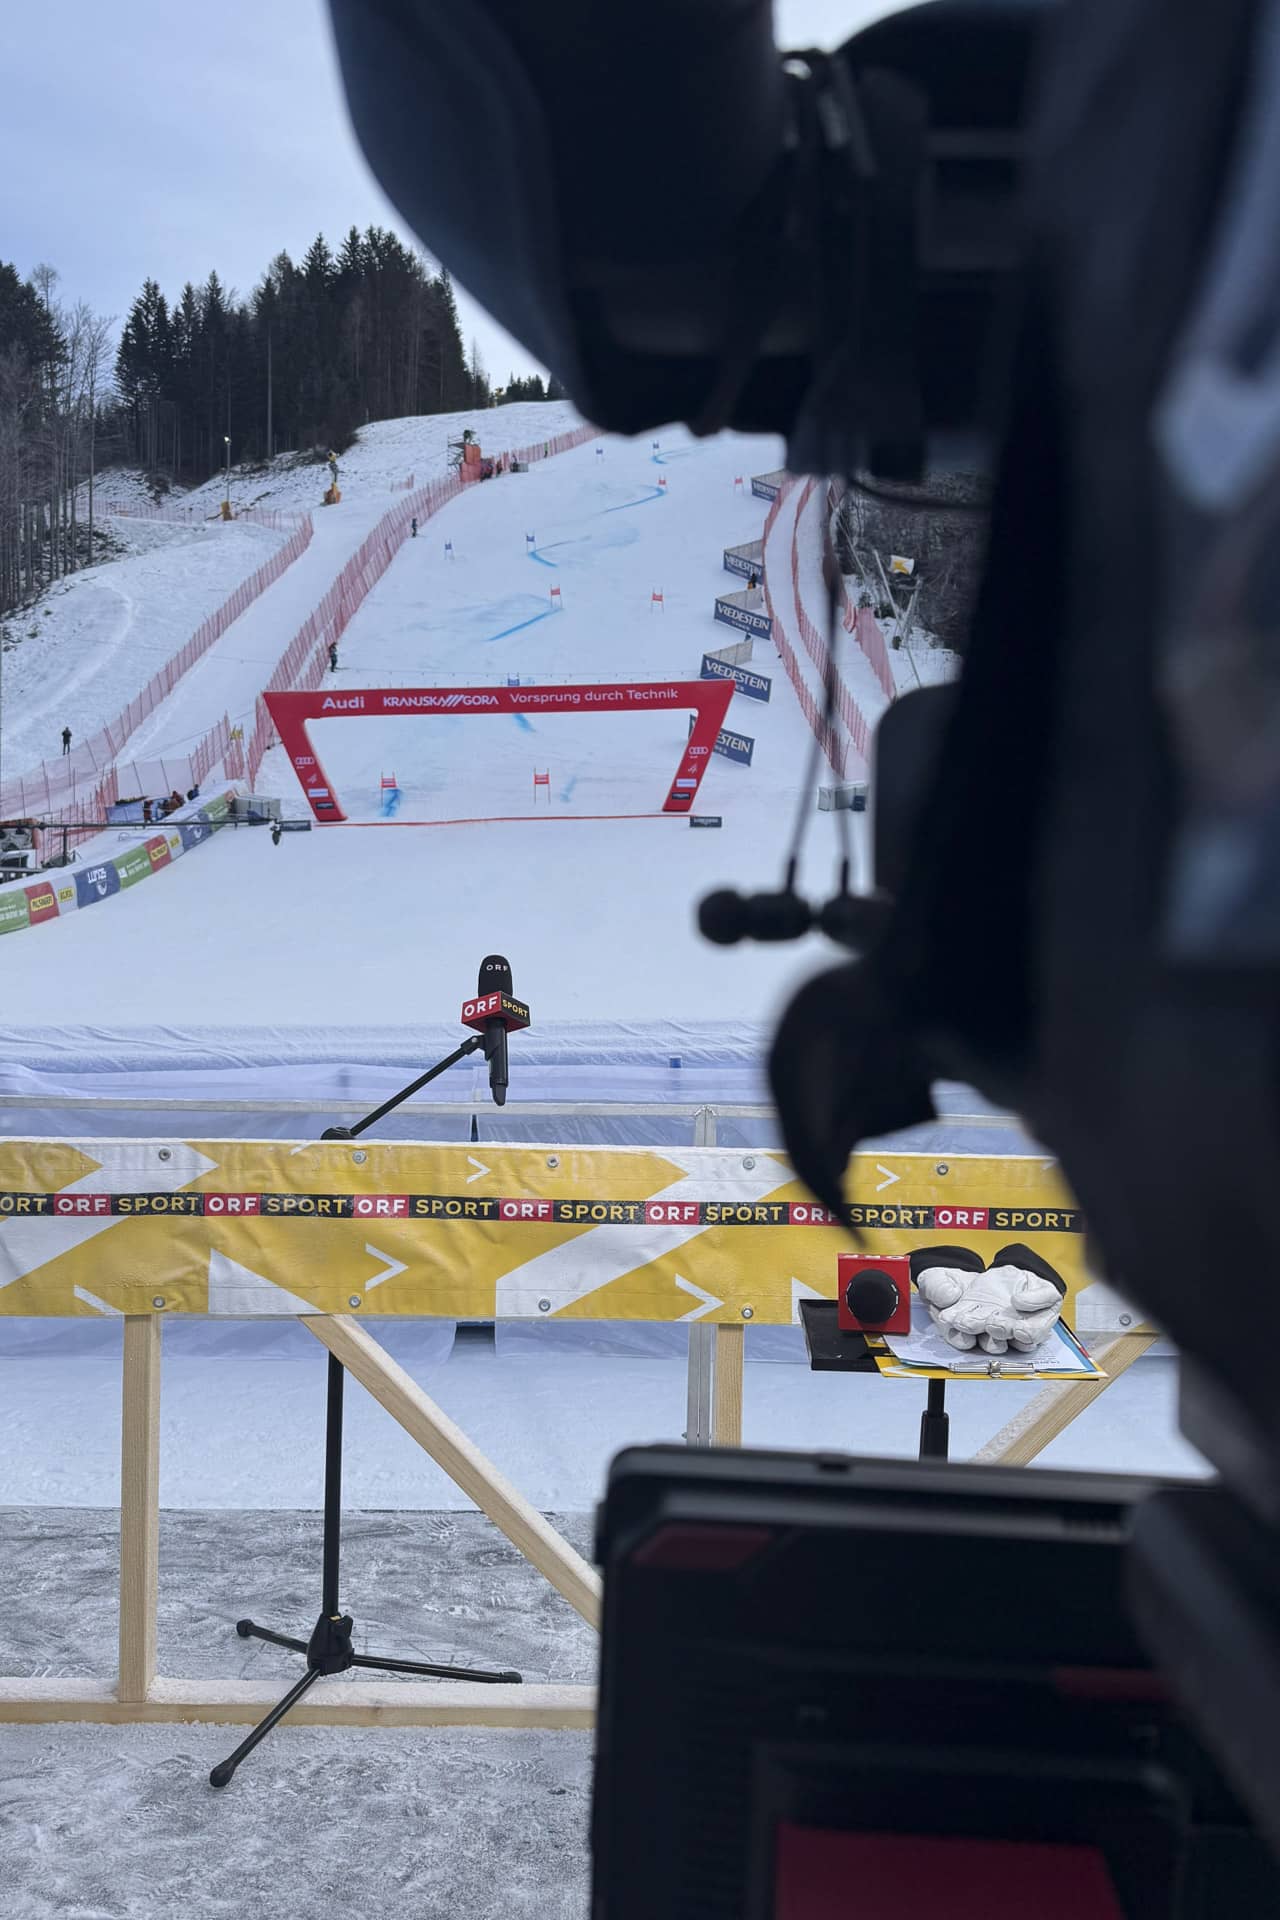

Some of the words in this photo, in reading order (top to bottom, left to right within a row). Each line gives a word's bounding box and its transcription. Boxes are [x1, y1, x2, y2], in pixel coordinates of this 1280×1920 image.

[717, 602, 769, 630] VREDESTEIN
[705, 660, 769, 691] VREDESTEIN
[322, 697, 365, 709] Audi
[510, 692, 581, 704] Vorsprung
[584, 690, 623, 701] durch
[626, 688, 679, 700] Technik
[717, 732, 751, 753] ESTEIN
[464, 995, 498, 1017] ORF
[502, 999, 529, 1018] SPORT
[58, 1198, 107, 1212] ORF
[118, 1196, 199, 1212] SPORT
[208, 1197, 257, 1212] ORF
[267, 1198, 347, 1213] SPORT
[358, 1199, 405, 1214] ORF
[416, 1199, 493, 1216] SPORT
[503, 1203, 549, 1217] ORF
[560, 1204, 639, 1220] SPORT
[650, 1206, 697, 1220] ORF
[706, 1206, 783, 1221] SPORT
[850, 1207, 928, 1225] SPORT
[938, 1210, 985, 1225] ORF
[995, 1212, 1075, 1228] SPORT
